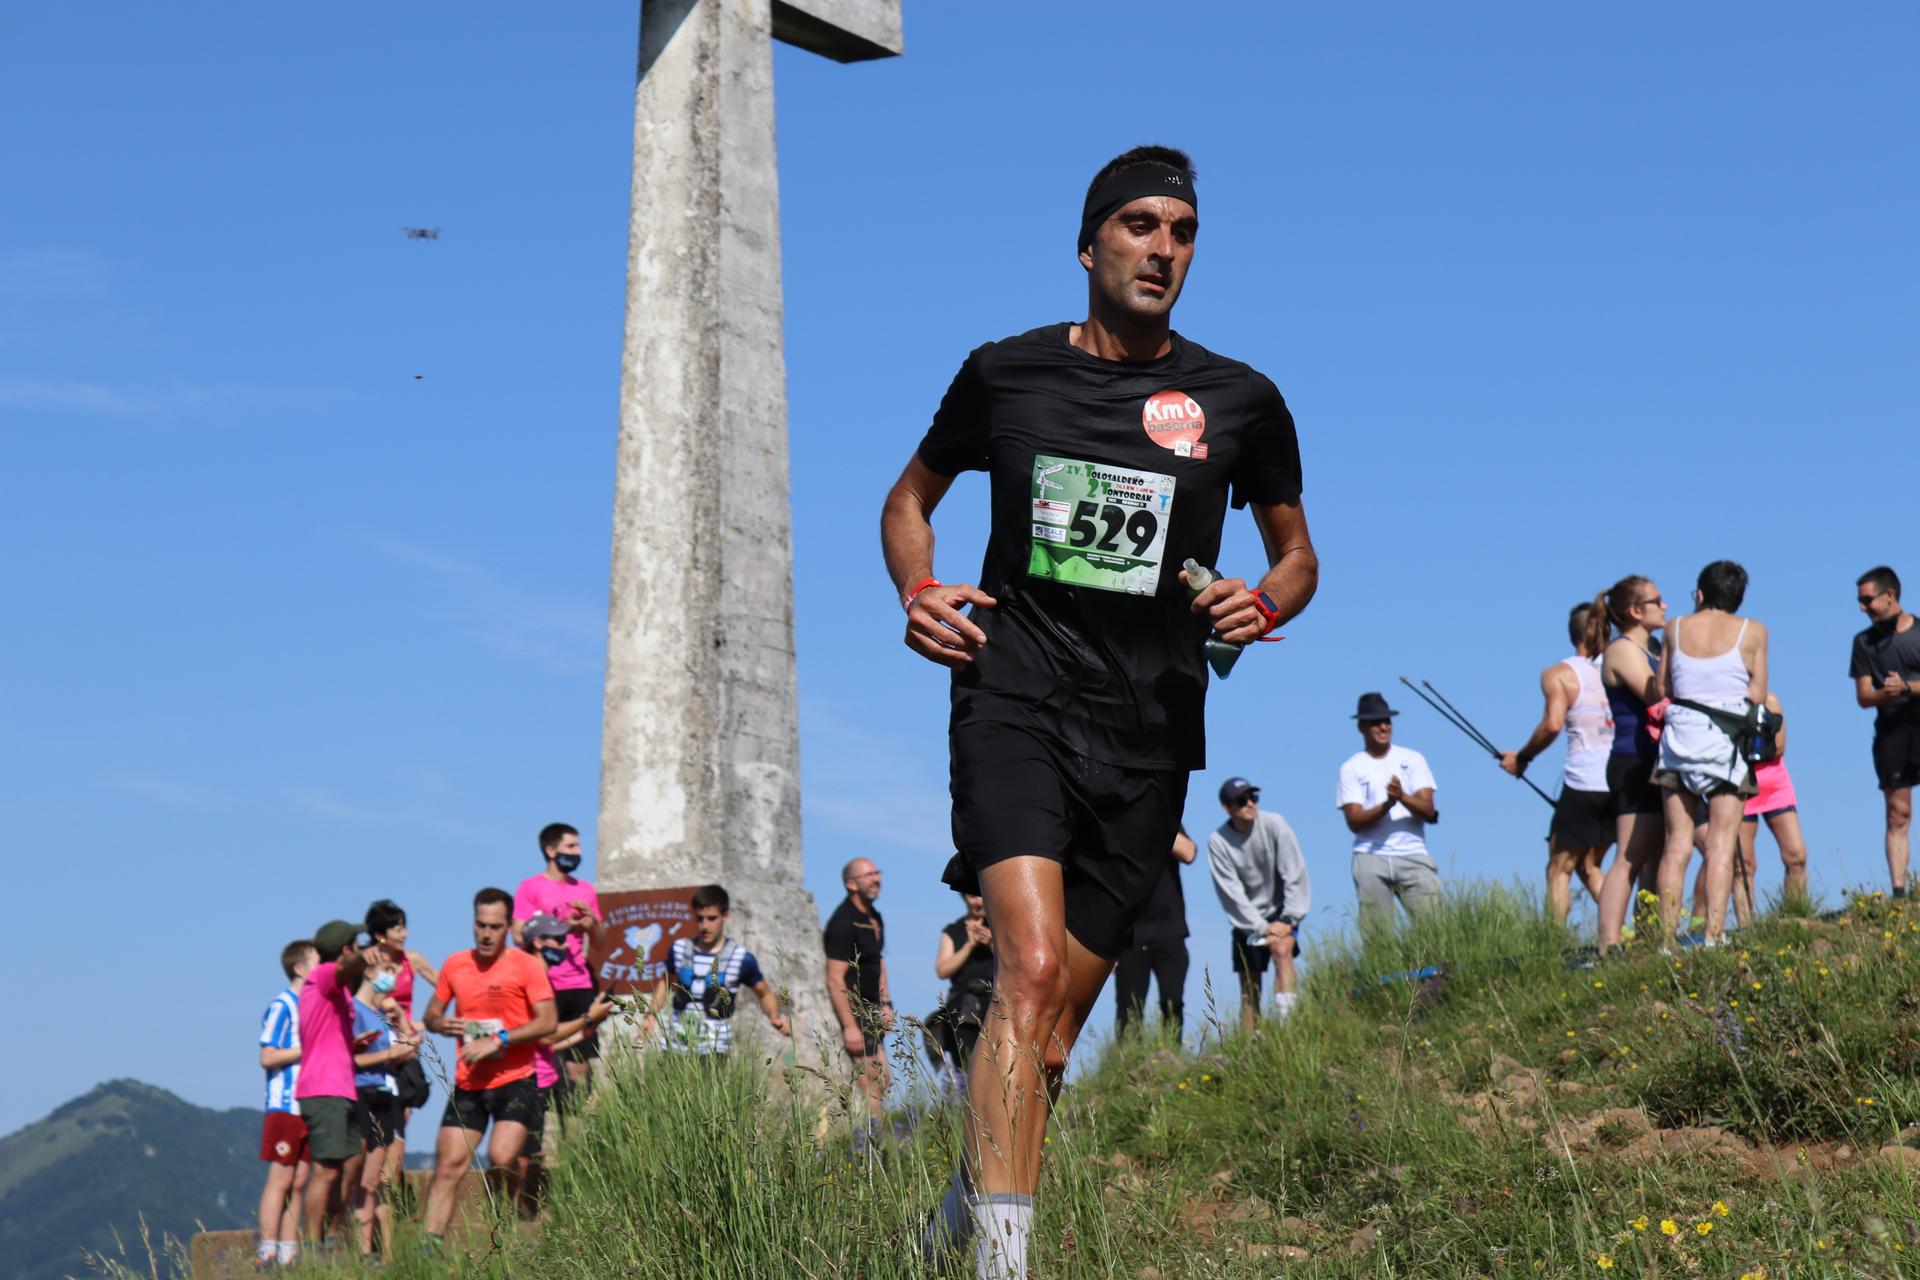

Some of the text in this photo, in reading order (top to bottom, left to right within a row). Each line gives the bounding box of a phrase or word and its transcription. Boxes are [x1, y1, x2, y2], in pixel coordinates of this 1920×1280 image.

[1144, 400, 1184, 421] Km
[1085, 464, 1144, 486] TOLOSALDEKO
[1087, 478, 1153, 502] 2 TONTORRAK
[1070, 501, 1158, 558] 529
[1360, 781, 1370, 800] 7
